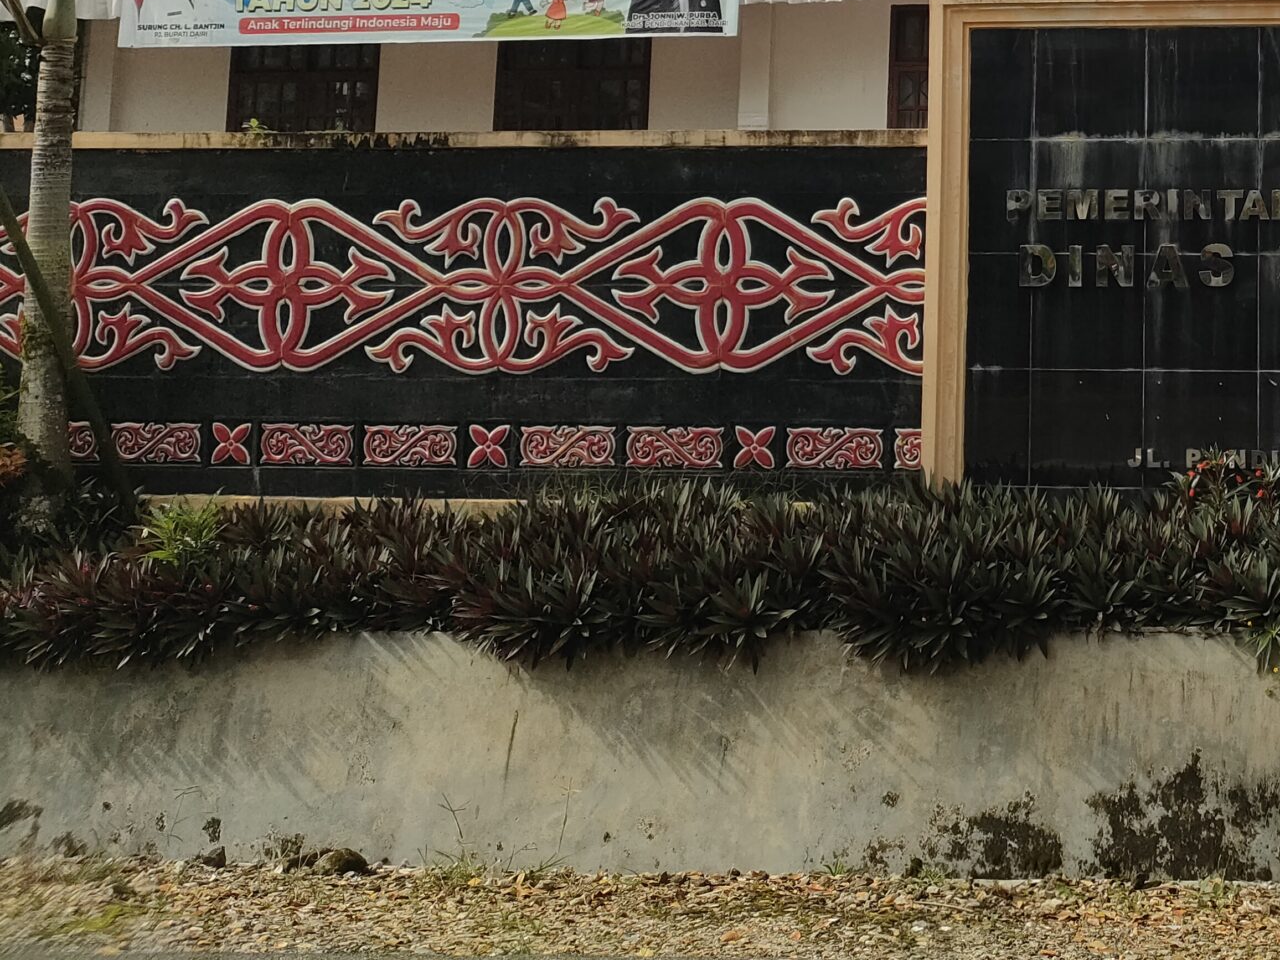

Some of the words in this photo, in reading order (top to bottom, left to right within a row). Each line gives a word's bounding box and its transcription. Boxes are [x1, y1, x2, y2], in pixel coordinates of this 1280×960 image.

[137, 23, 168, 31] SURUNG
[247, 20, 280, 30] Anak
[282, 18, 353, 31] Terlindungi
[355, 16, 417, 28] Indonesia
[420, 15, 452, 28] Maju
[1018, 243, 1236, 289] DINAS
[1127, 448, 1171, 469] JL.
